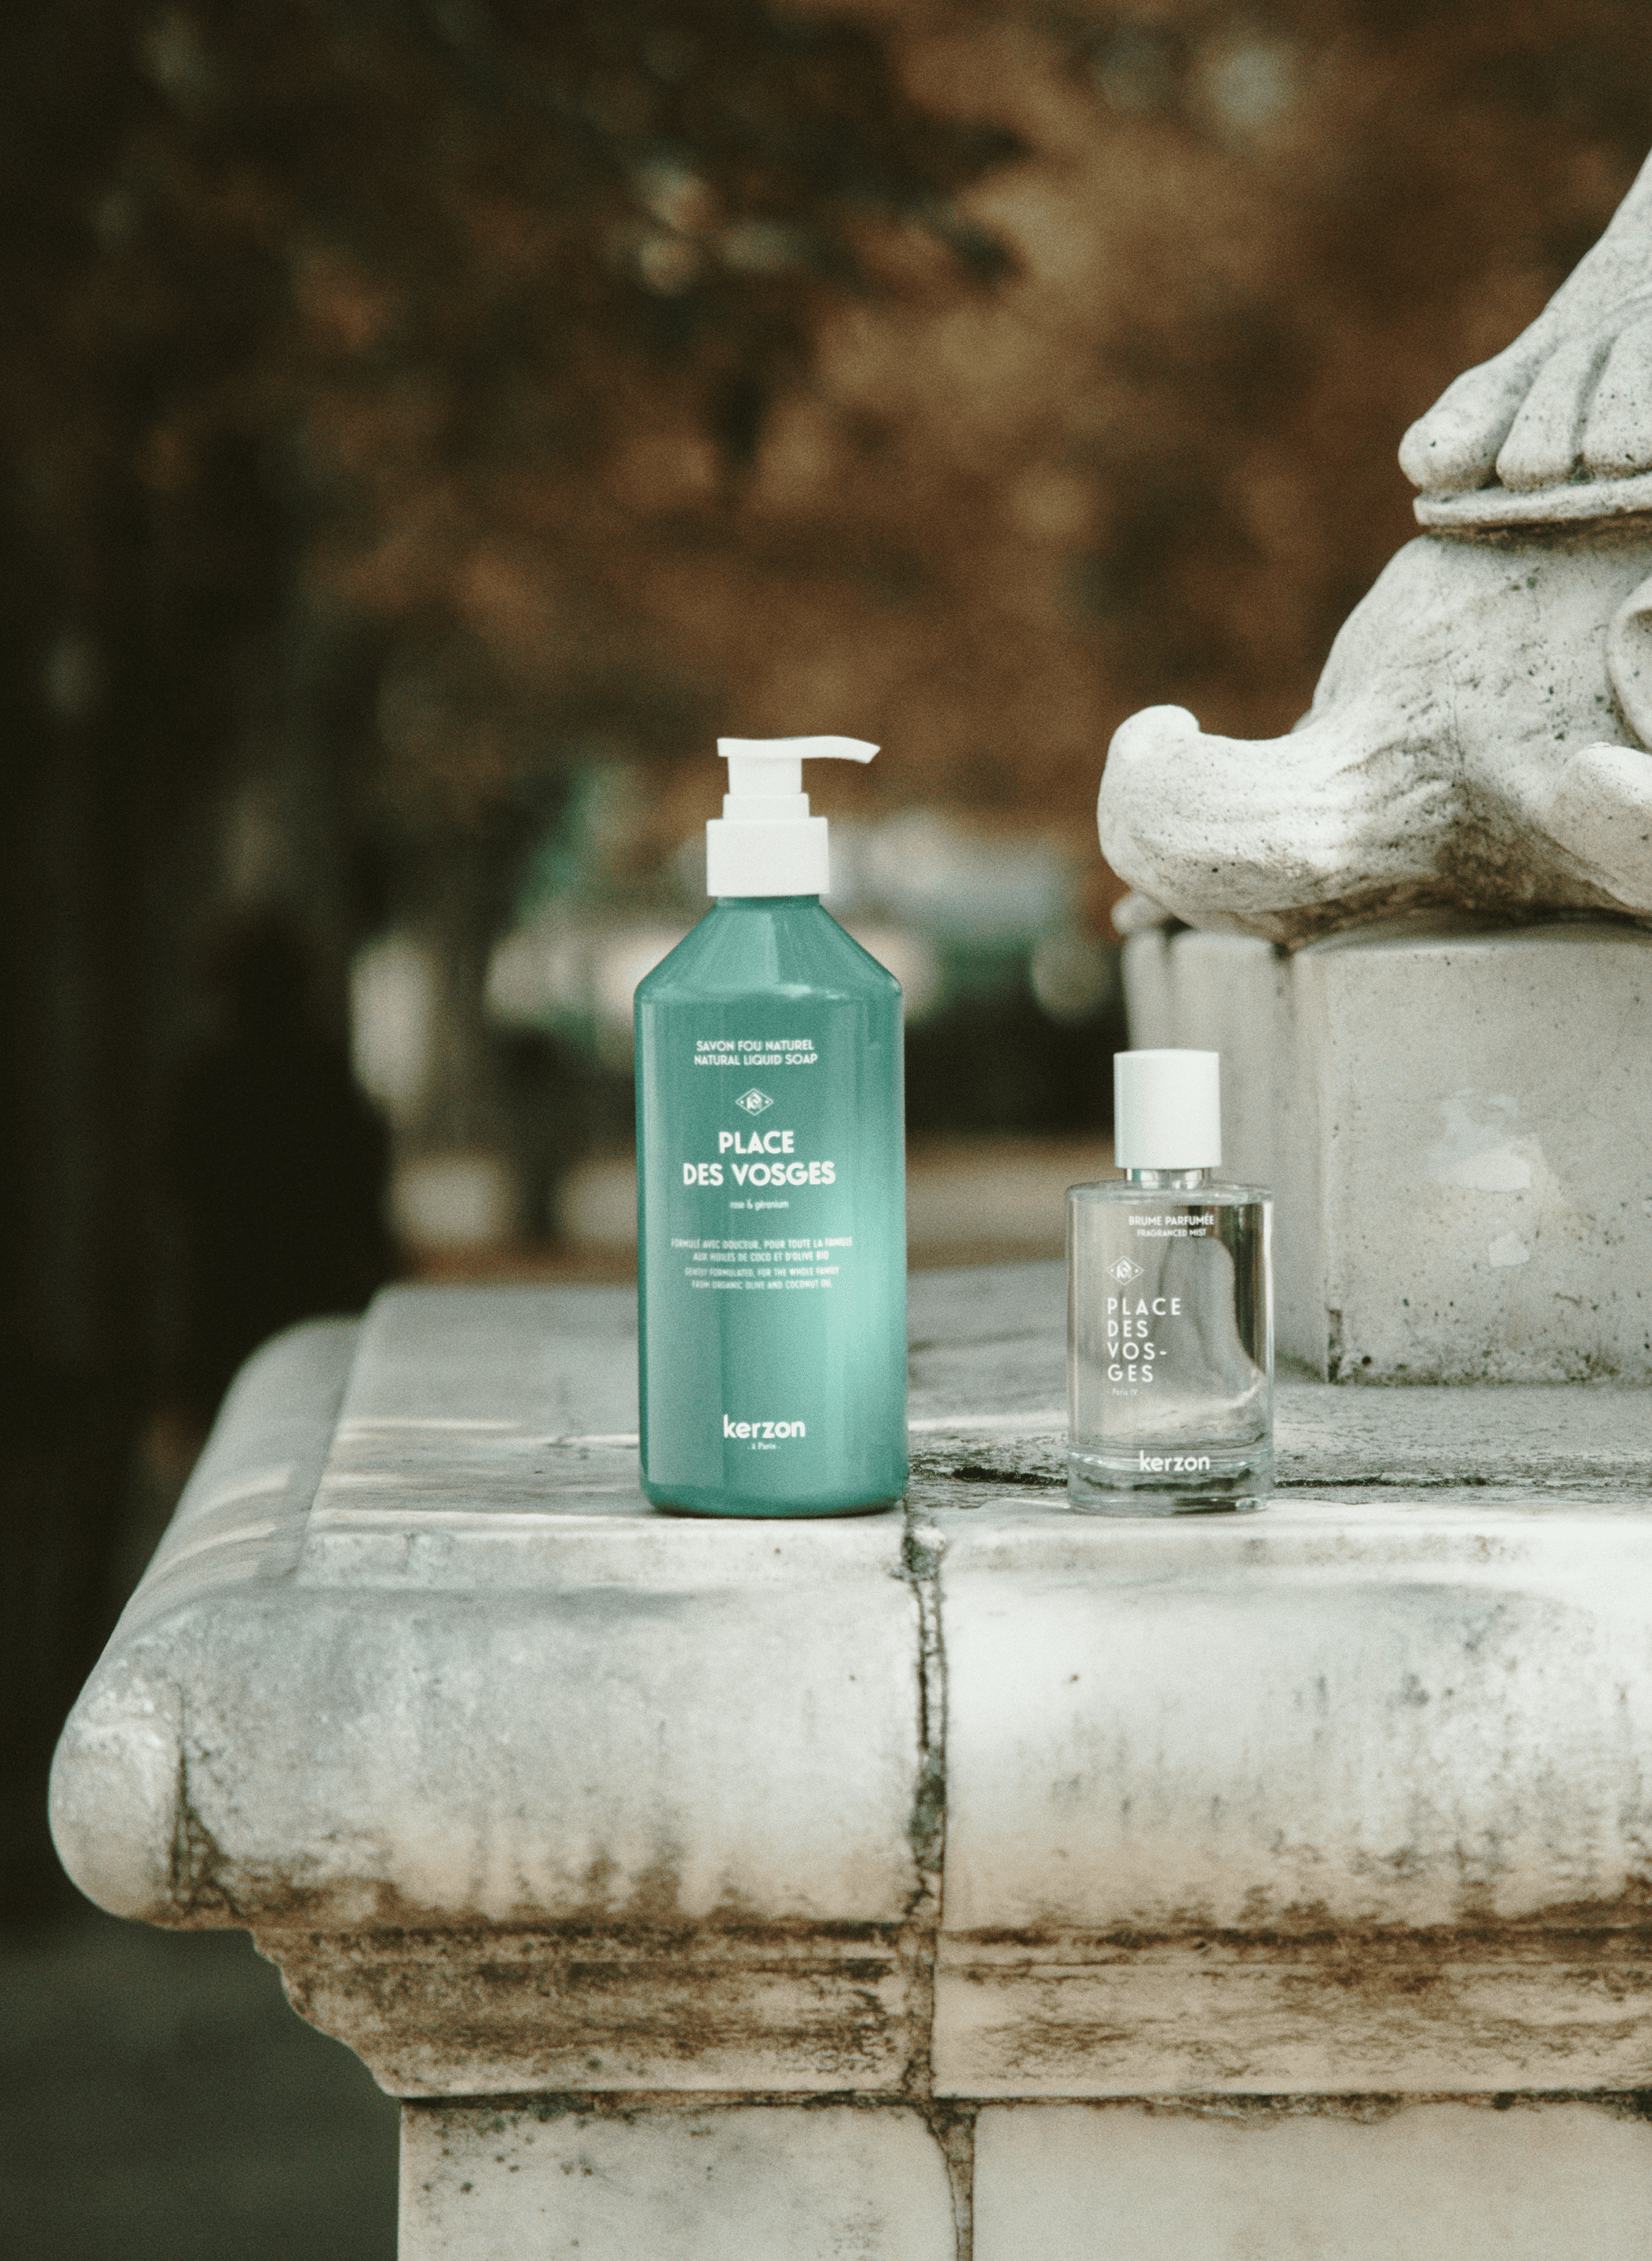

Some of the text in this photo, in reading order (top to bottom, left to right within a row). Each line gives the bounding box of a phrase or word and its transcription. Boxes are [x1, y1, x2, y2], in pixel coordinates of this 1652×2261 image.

[696, 1039, 814, 1051] SAVON FOU NATUREL
[694, 1053, 818, 1065] NATURAL LIQUID SOAP
[719, 1130, 794, 1154] PLACE
[683, 1162, 836, 1186] DES VOSGES
[1129, 1213, 1214, 1226] BRUME PARFUMÉE
[788, 1239, 810, 1248] TOUTE
[813, 1239, 823, 1248] LA
[1107, 1297, 1181, 1316] PLACE
[1107, 1320, 1148, 1338] DES
[1107, 1342, 1167, 1361] VOS-
[1107, 1364, 1153, 1383] GES
[724, 1414, 806, 1439] kerzon
[1139, 1451, 1210, 1472] kerzon
